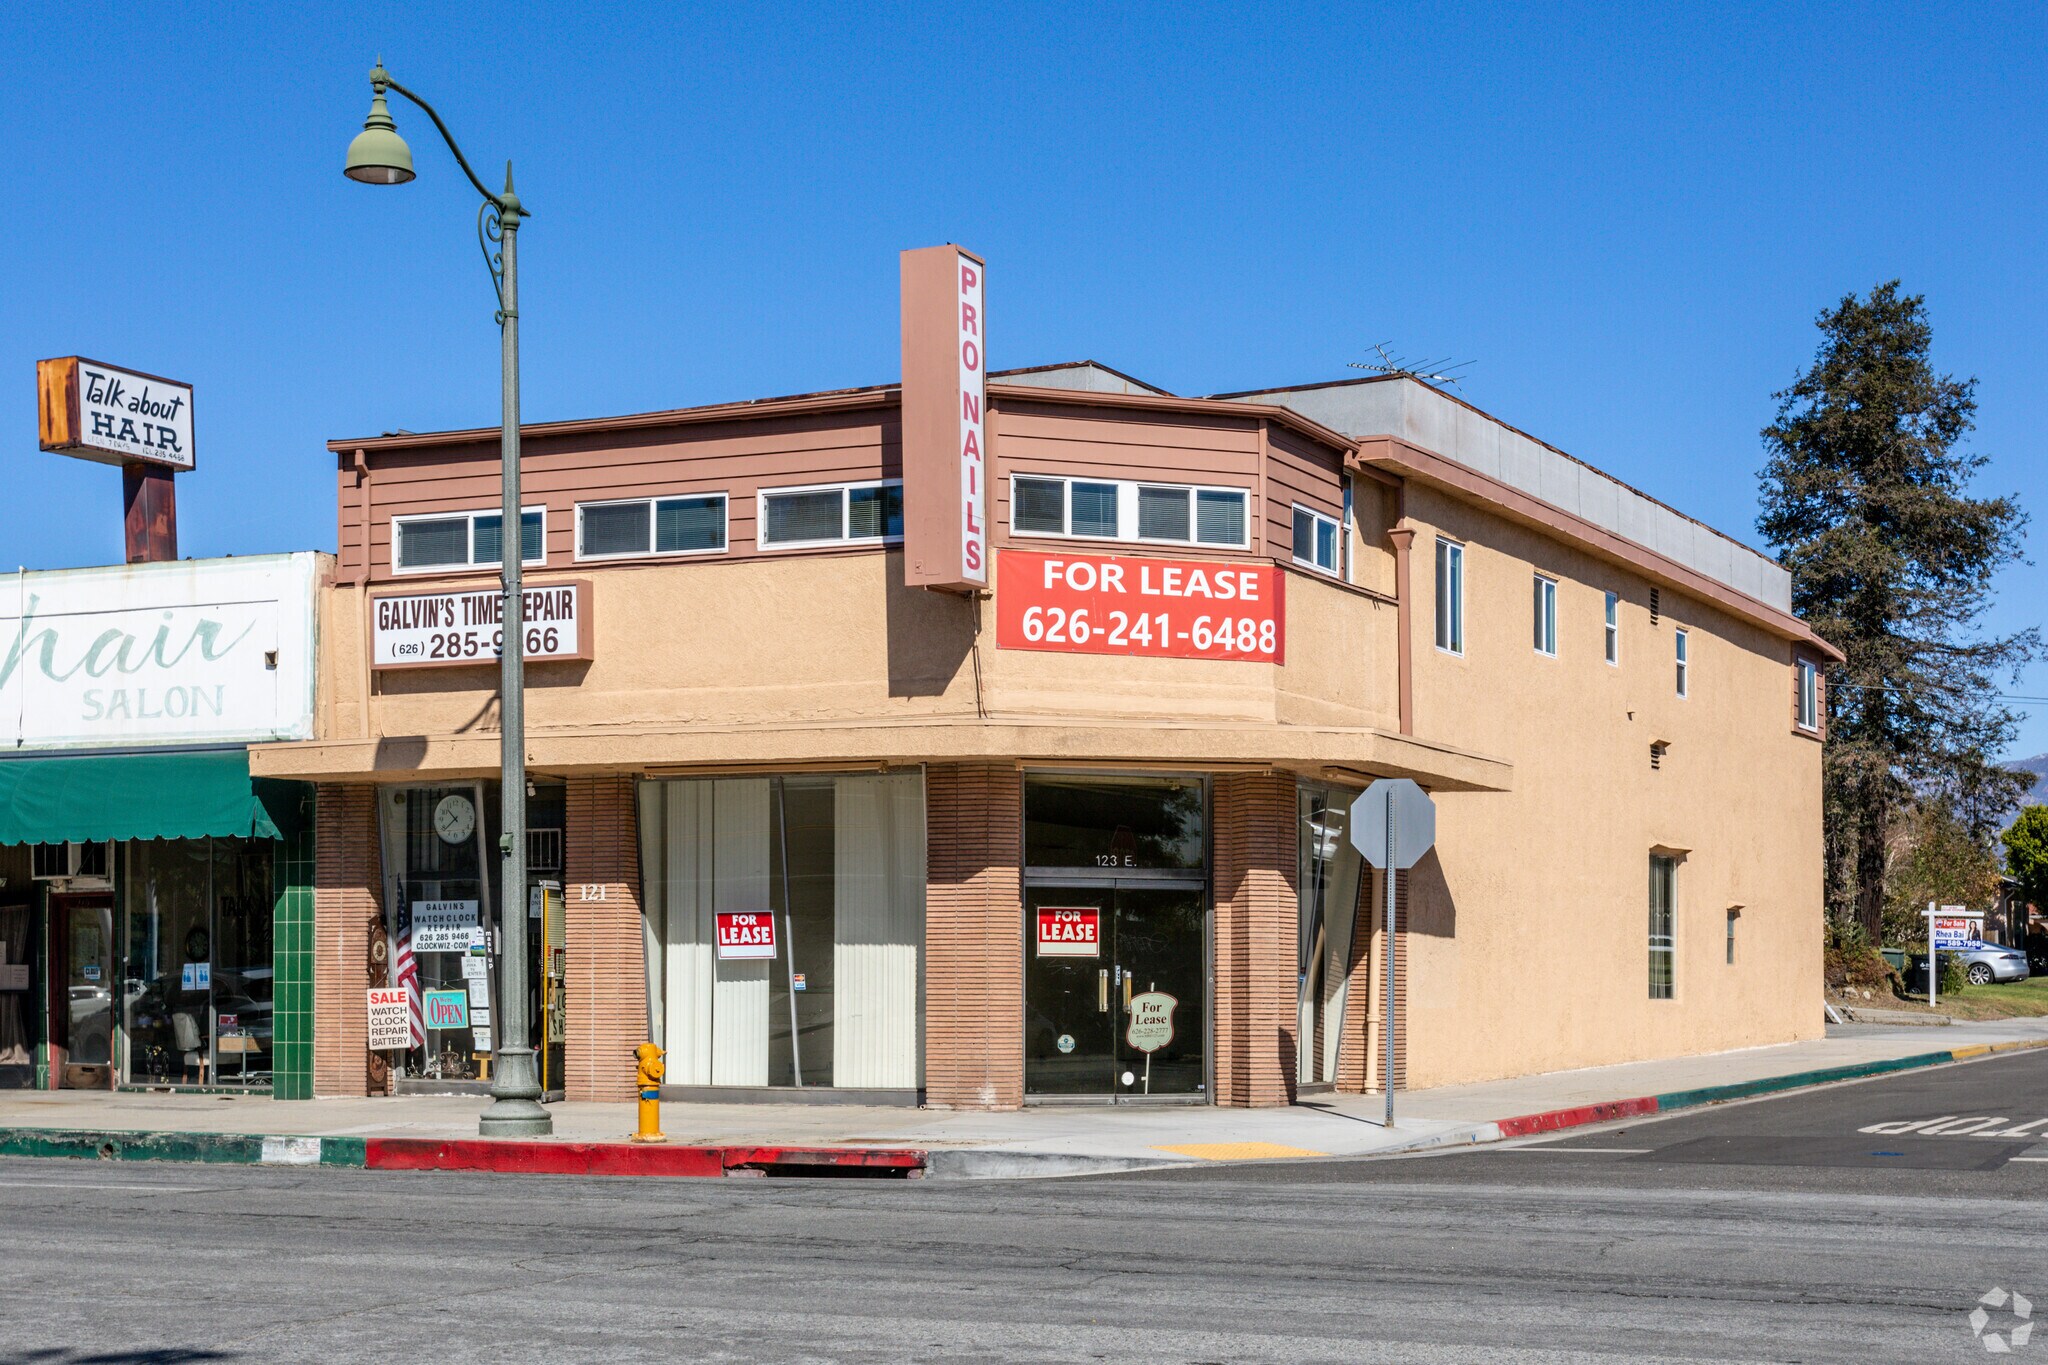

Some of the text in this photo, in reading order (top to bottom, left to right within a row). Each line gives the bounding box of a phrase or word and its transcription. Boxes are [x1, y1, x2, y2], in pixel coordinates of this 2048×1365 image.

[85, 370, 185, 422] Talk about
[961, 265, 981, 570] PRO NAILS
[91, 410, 183, 453] HAIR
[1044, 560, 1259, 601] FOR LEASE
[379, 589, 573, 631] GALVIN'S TIME EPAIR
[1022, 605, 1276, 654] 626-241-6488
[0, 592, 256, 689] hair
[392, 627, 559, 658] (626) 285-966
[82, 684, 226, 721] SALON
[1095, 854, 1137, 867] 123 E.
[579, 884, 607, 901] 121
[414, 913, 476, 923] WATCH CLOCK
[732, 914, 757, 926] FOR
[1055, 910, 1081, 922] FOR
[427, 924, 461, 932] REPAIR
[1041, 923, 1095, 941] LEASE
[1936, 930, 1952, 938] Rhea
[419, 932, 469, 942] 626 285 9466
[720, 926, 771, 944] LEASE
[370, 991, 407, 1004] SALE
[371, 1006, 407, 1016] WATCH
[430, 997, 463, 1025] OPEN
[1142, 1002, 1163, 1013] For
[371, 1016, 407, 1026] CLOCK
[1135, 1014, 1167, 1025] Lease
[371, 1026, 408, 1036] REPAIR
[372, 1036, 408, 1047] BATTERY
